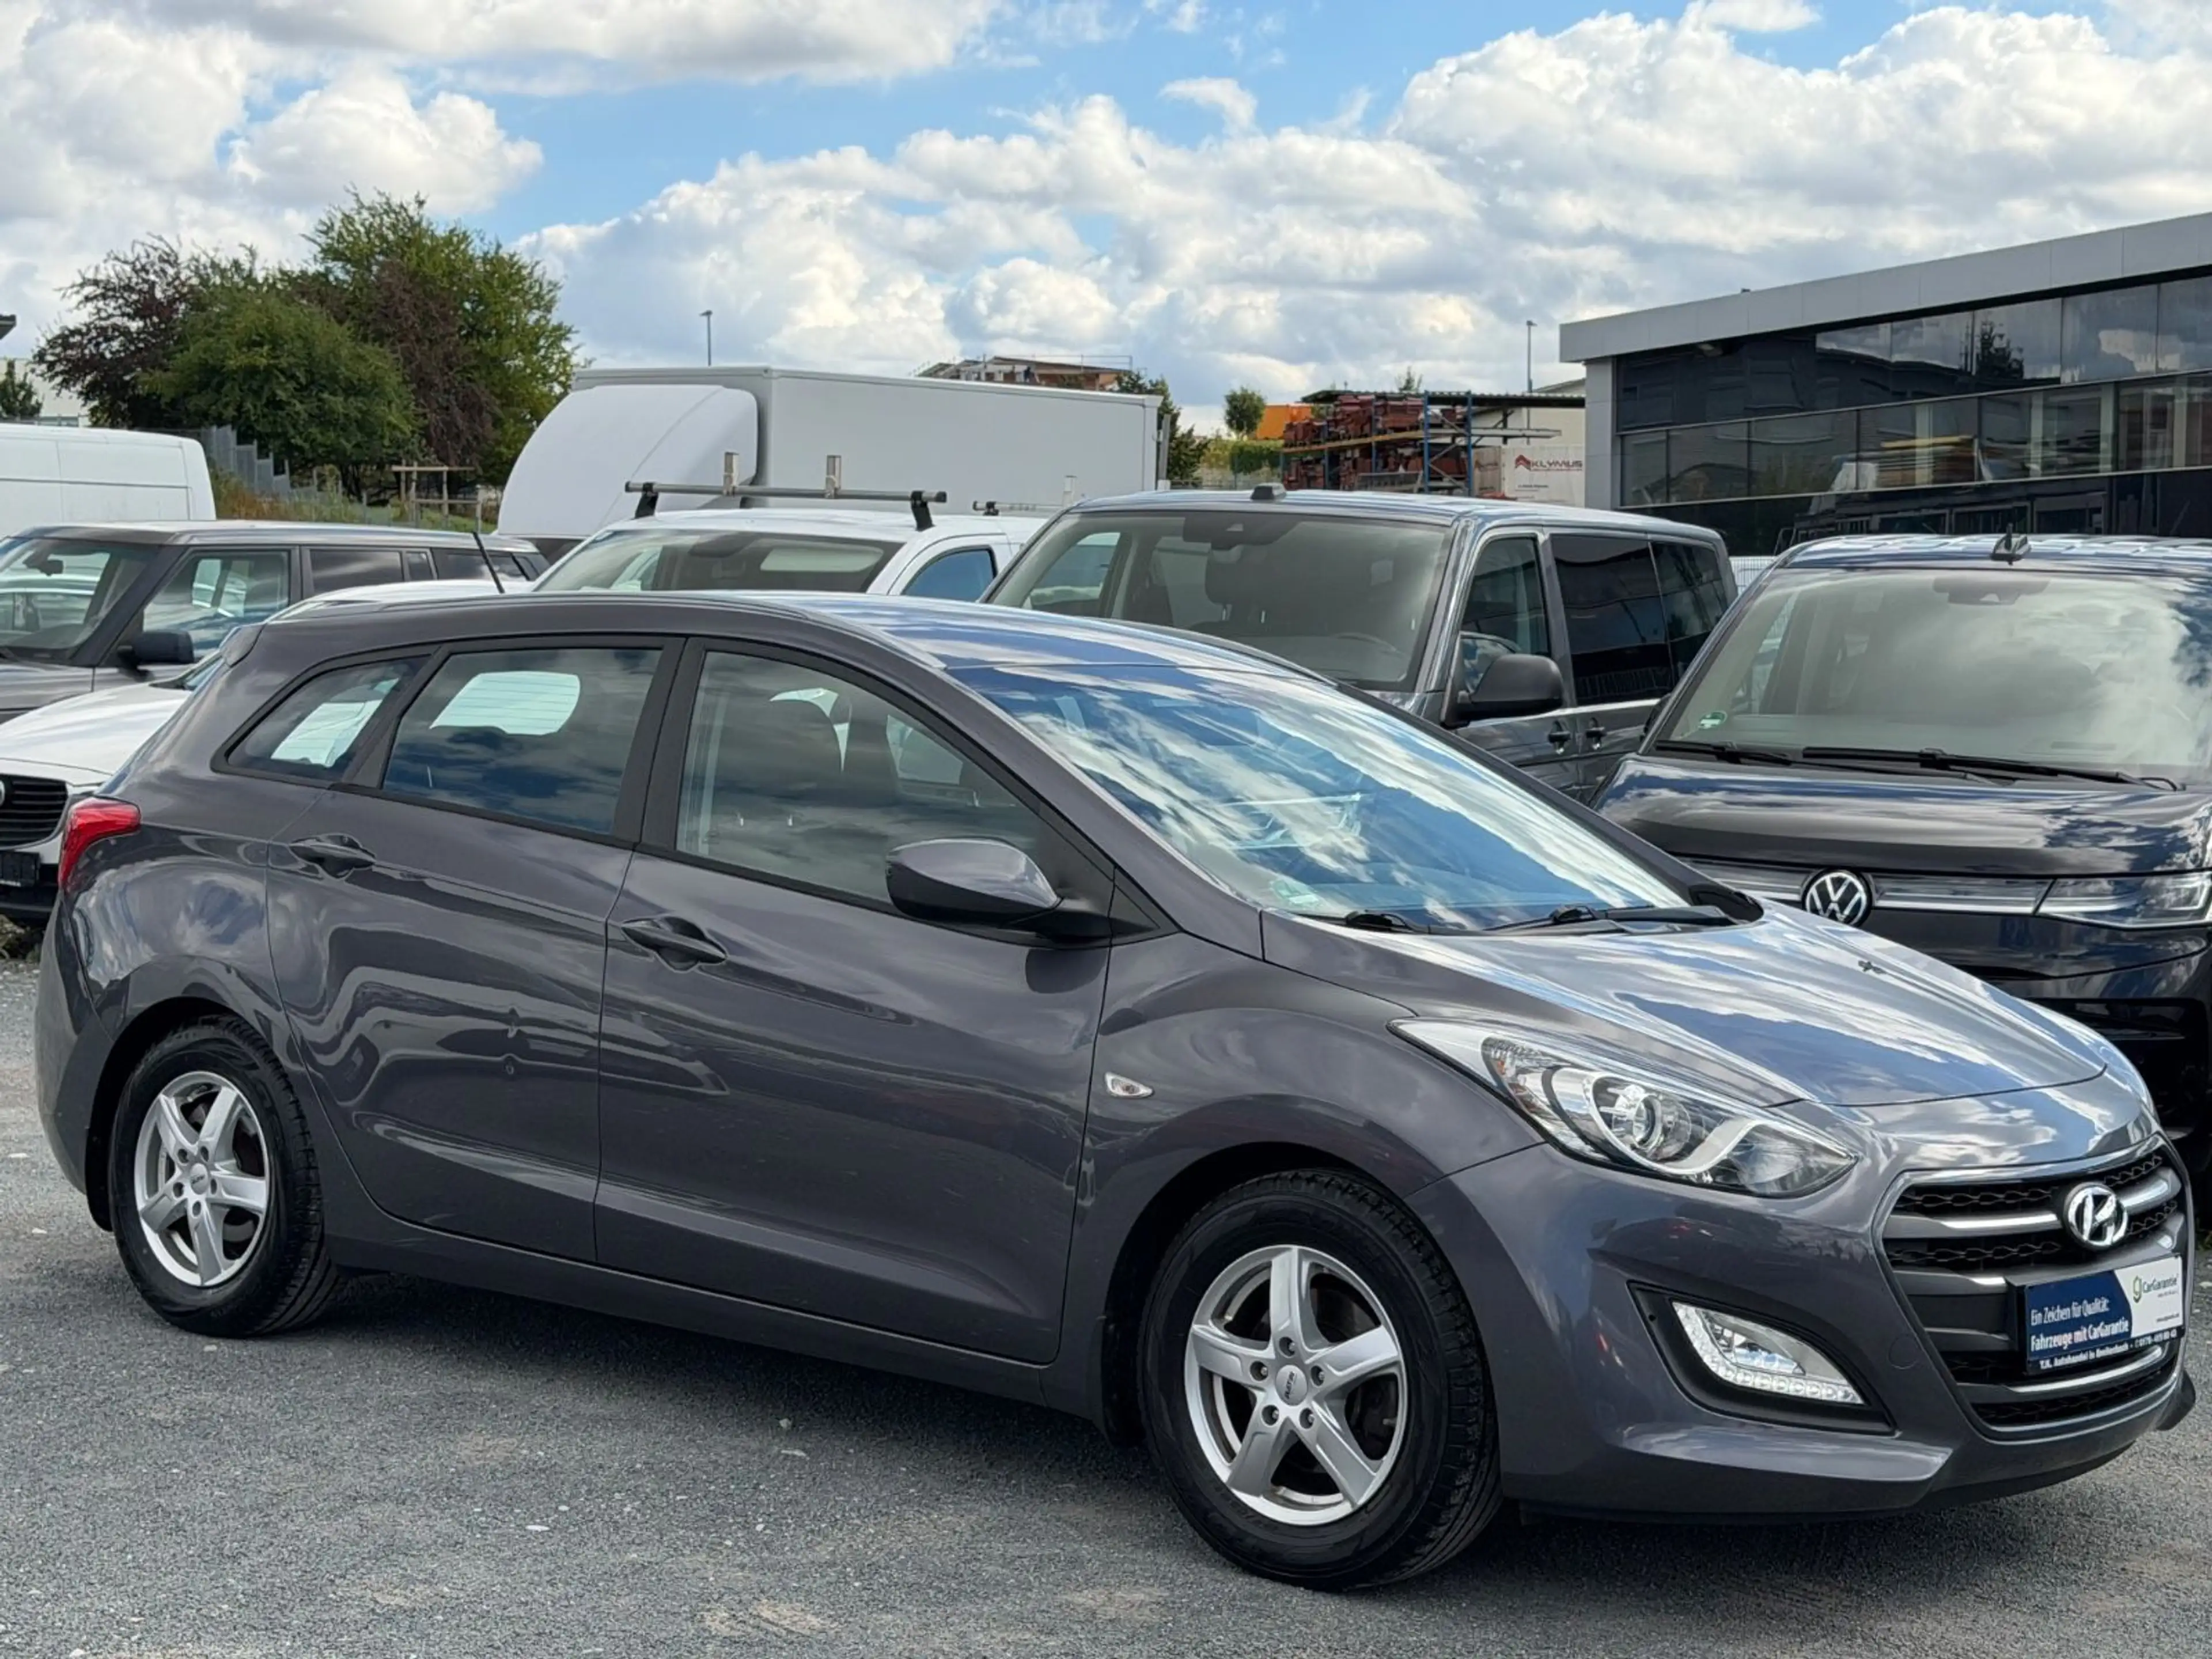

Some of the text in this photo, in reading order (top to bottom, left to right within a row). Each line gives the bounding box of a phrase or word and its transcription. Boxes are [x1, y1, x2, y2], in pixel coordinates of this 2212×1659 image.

[1531, 460, 1583, 468] KLYMUS
[2031, 1309, 2042, 1326] Ein
[2043, 1304, 2071, 1324] Zeichen
[2071, 1300, 2081, 1318] für
[2031, 1332, 2073, 1351] Fahrzeuge
[2074, 1325, 2088, 1343] mit
[2088, 1316, 2130, 1340] CarGarantie
